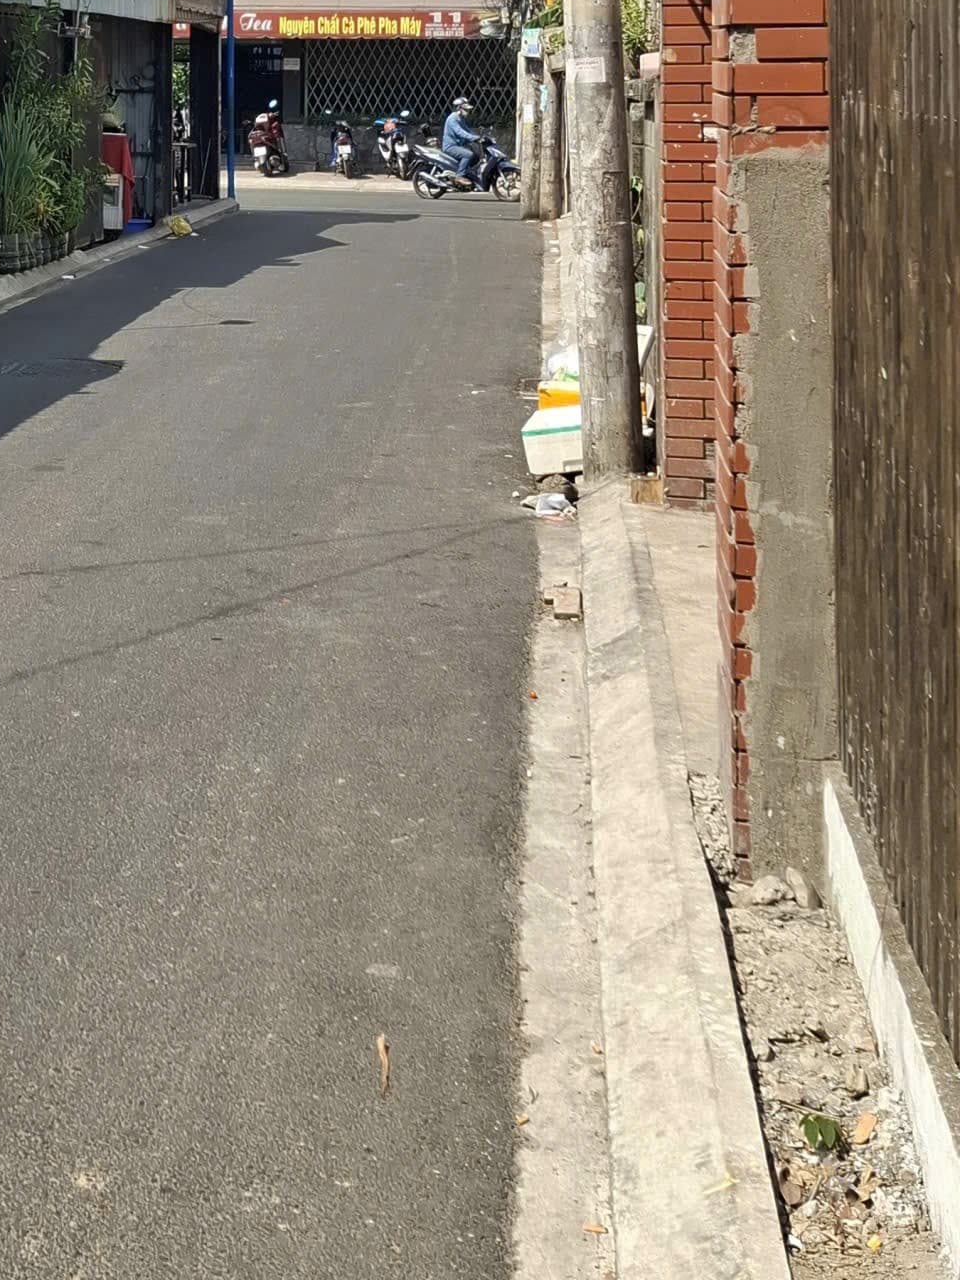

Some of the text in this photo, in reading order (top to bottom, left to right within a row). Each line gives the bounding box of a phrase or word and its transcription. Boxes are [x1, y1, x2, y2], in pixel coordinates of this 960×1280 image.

[240, 13, 272, 31] Tea
[279, 16, 315, 36] Nguyên
[318, 13, 340, 34] Chất
[342, 16, 355, 34] Cà
[357, 16, 376, 35] Phê
[379, 16, 398, 35] Pha
[400, 16, 421, 37] Máy
